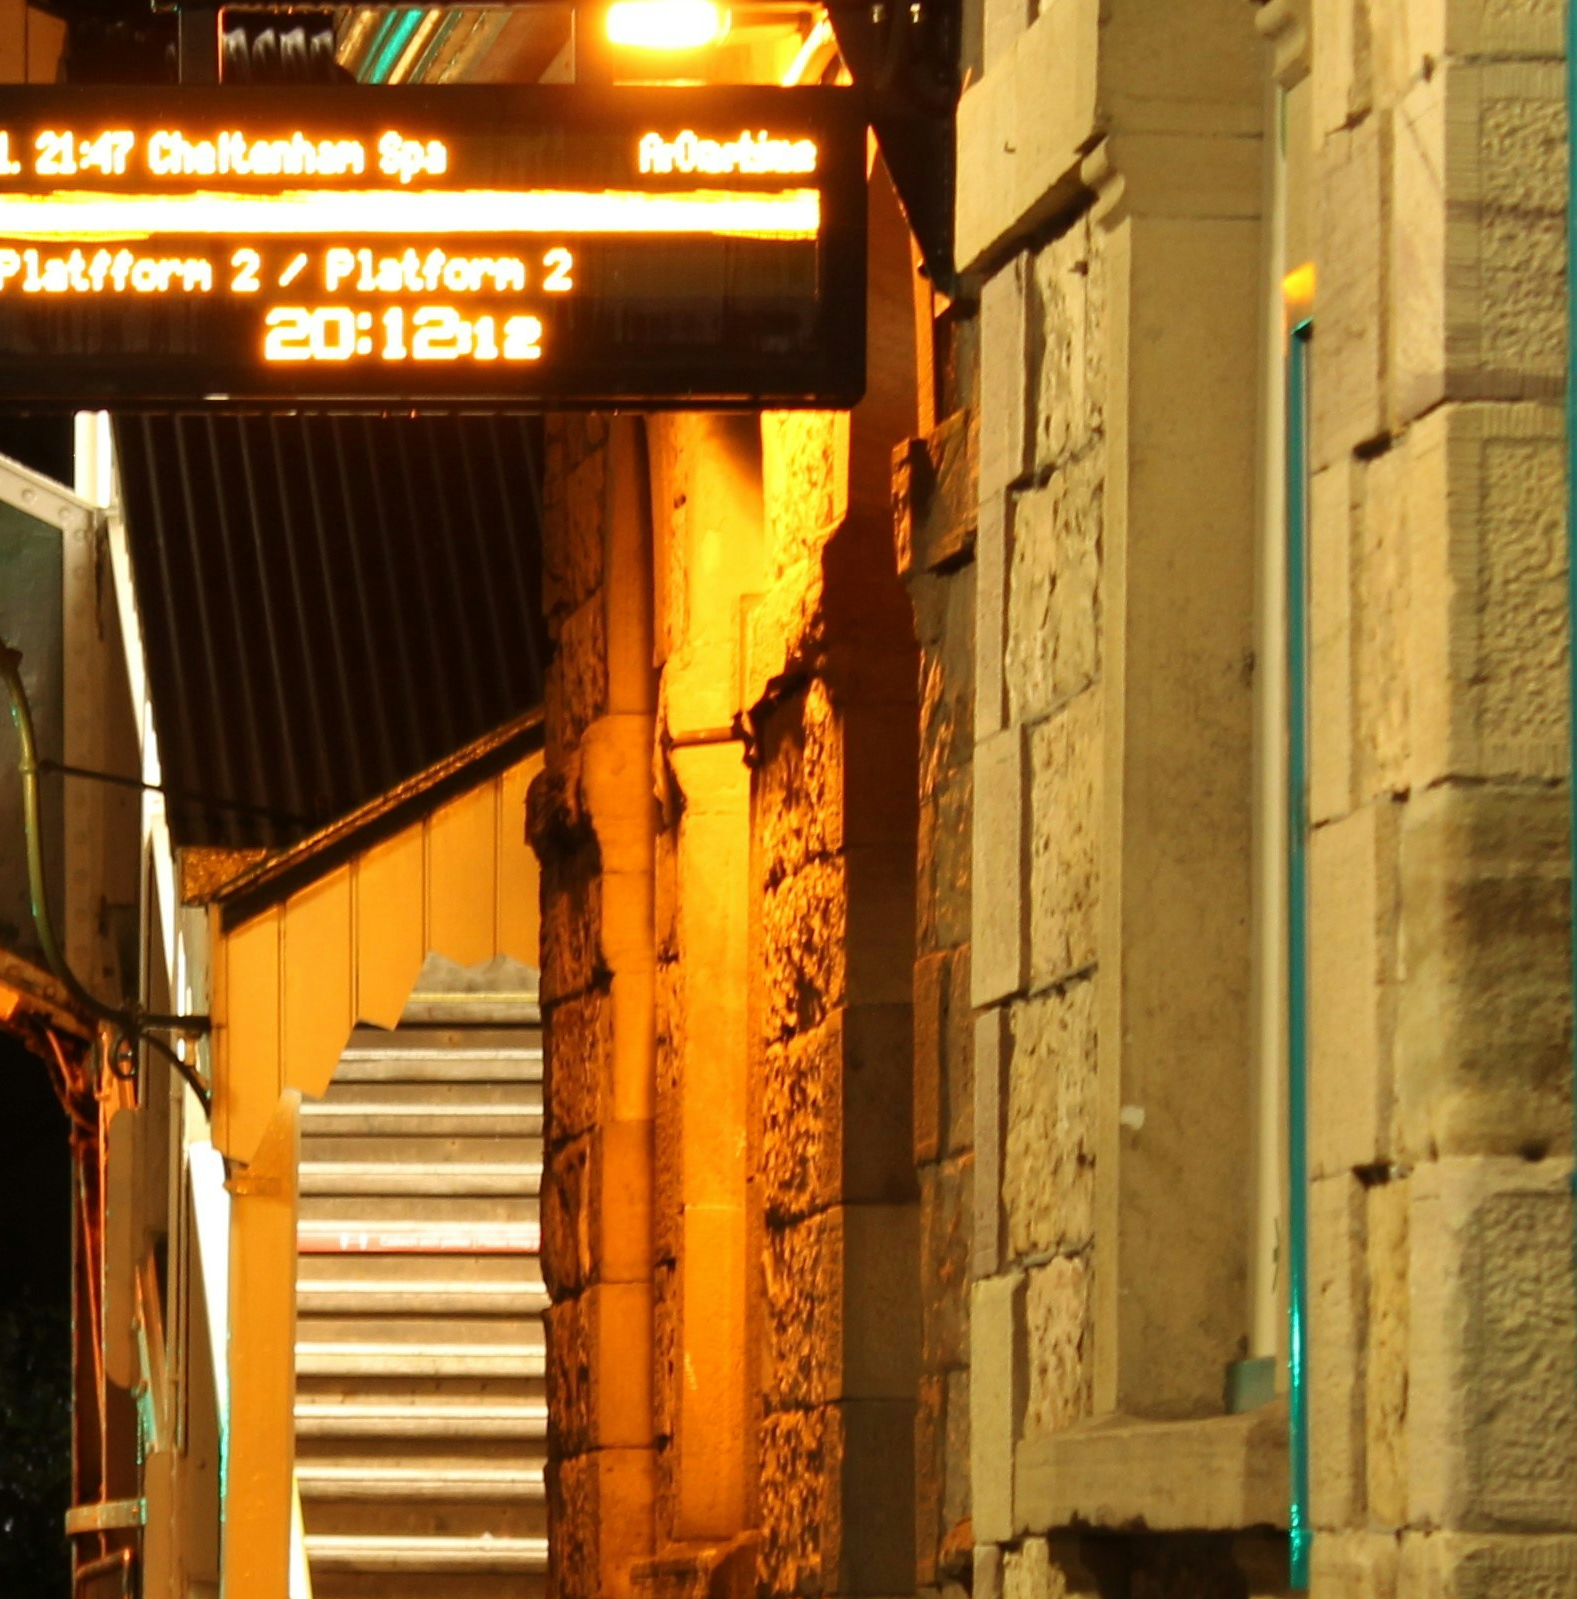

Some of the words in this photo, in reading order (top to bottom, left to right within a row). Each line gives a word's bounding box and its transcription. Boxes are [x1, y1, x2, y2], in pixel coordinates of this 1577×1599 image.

[34, 130, 136, 175] 21:47
[147, 130, 366, 175] Cheltenham
[377, 130, 448, 184] Spa
[230, 248, 262, 292] 2
[325, 248, 526, 292] Platform
[542, 248, 574, 292] 2
